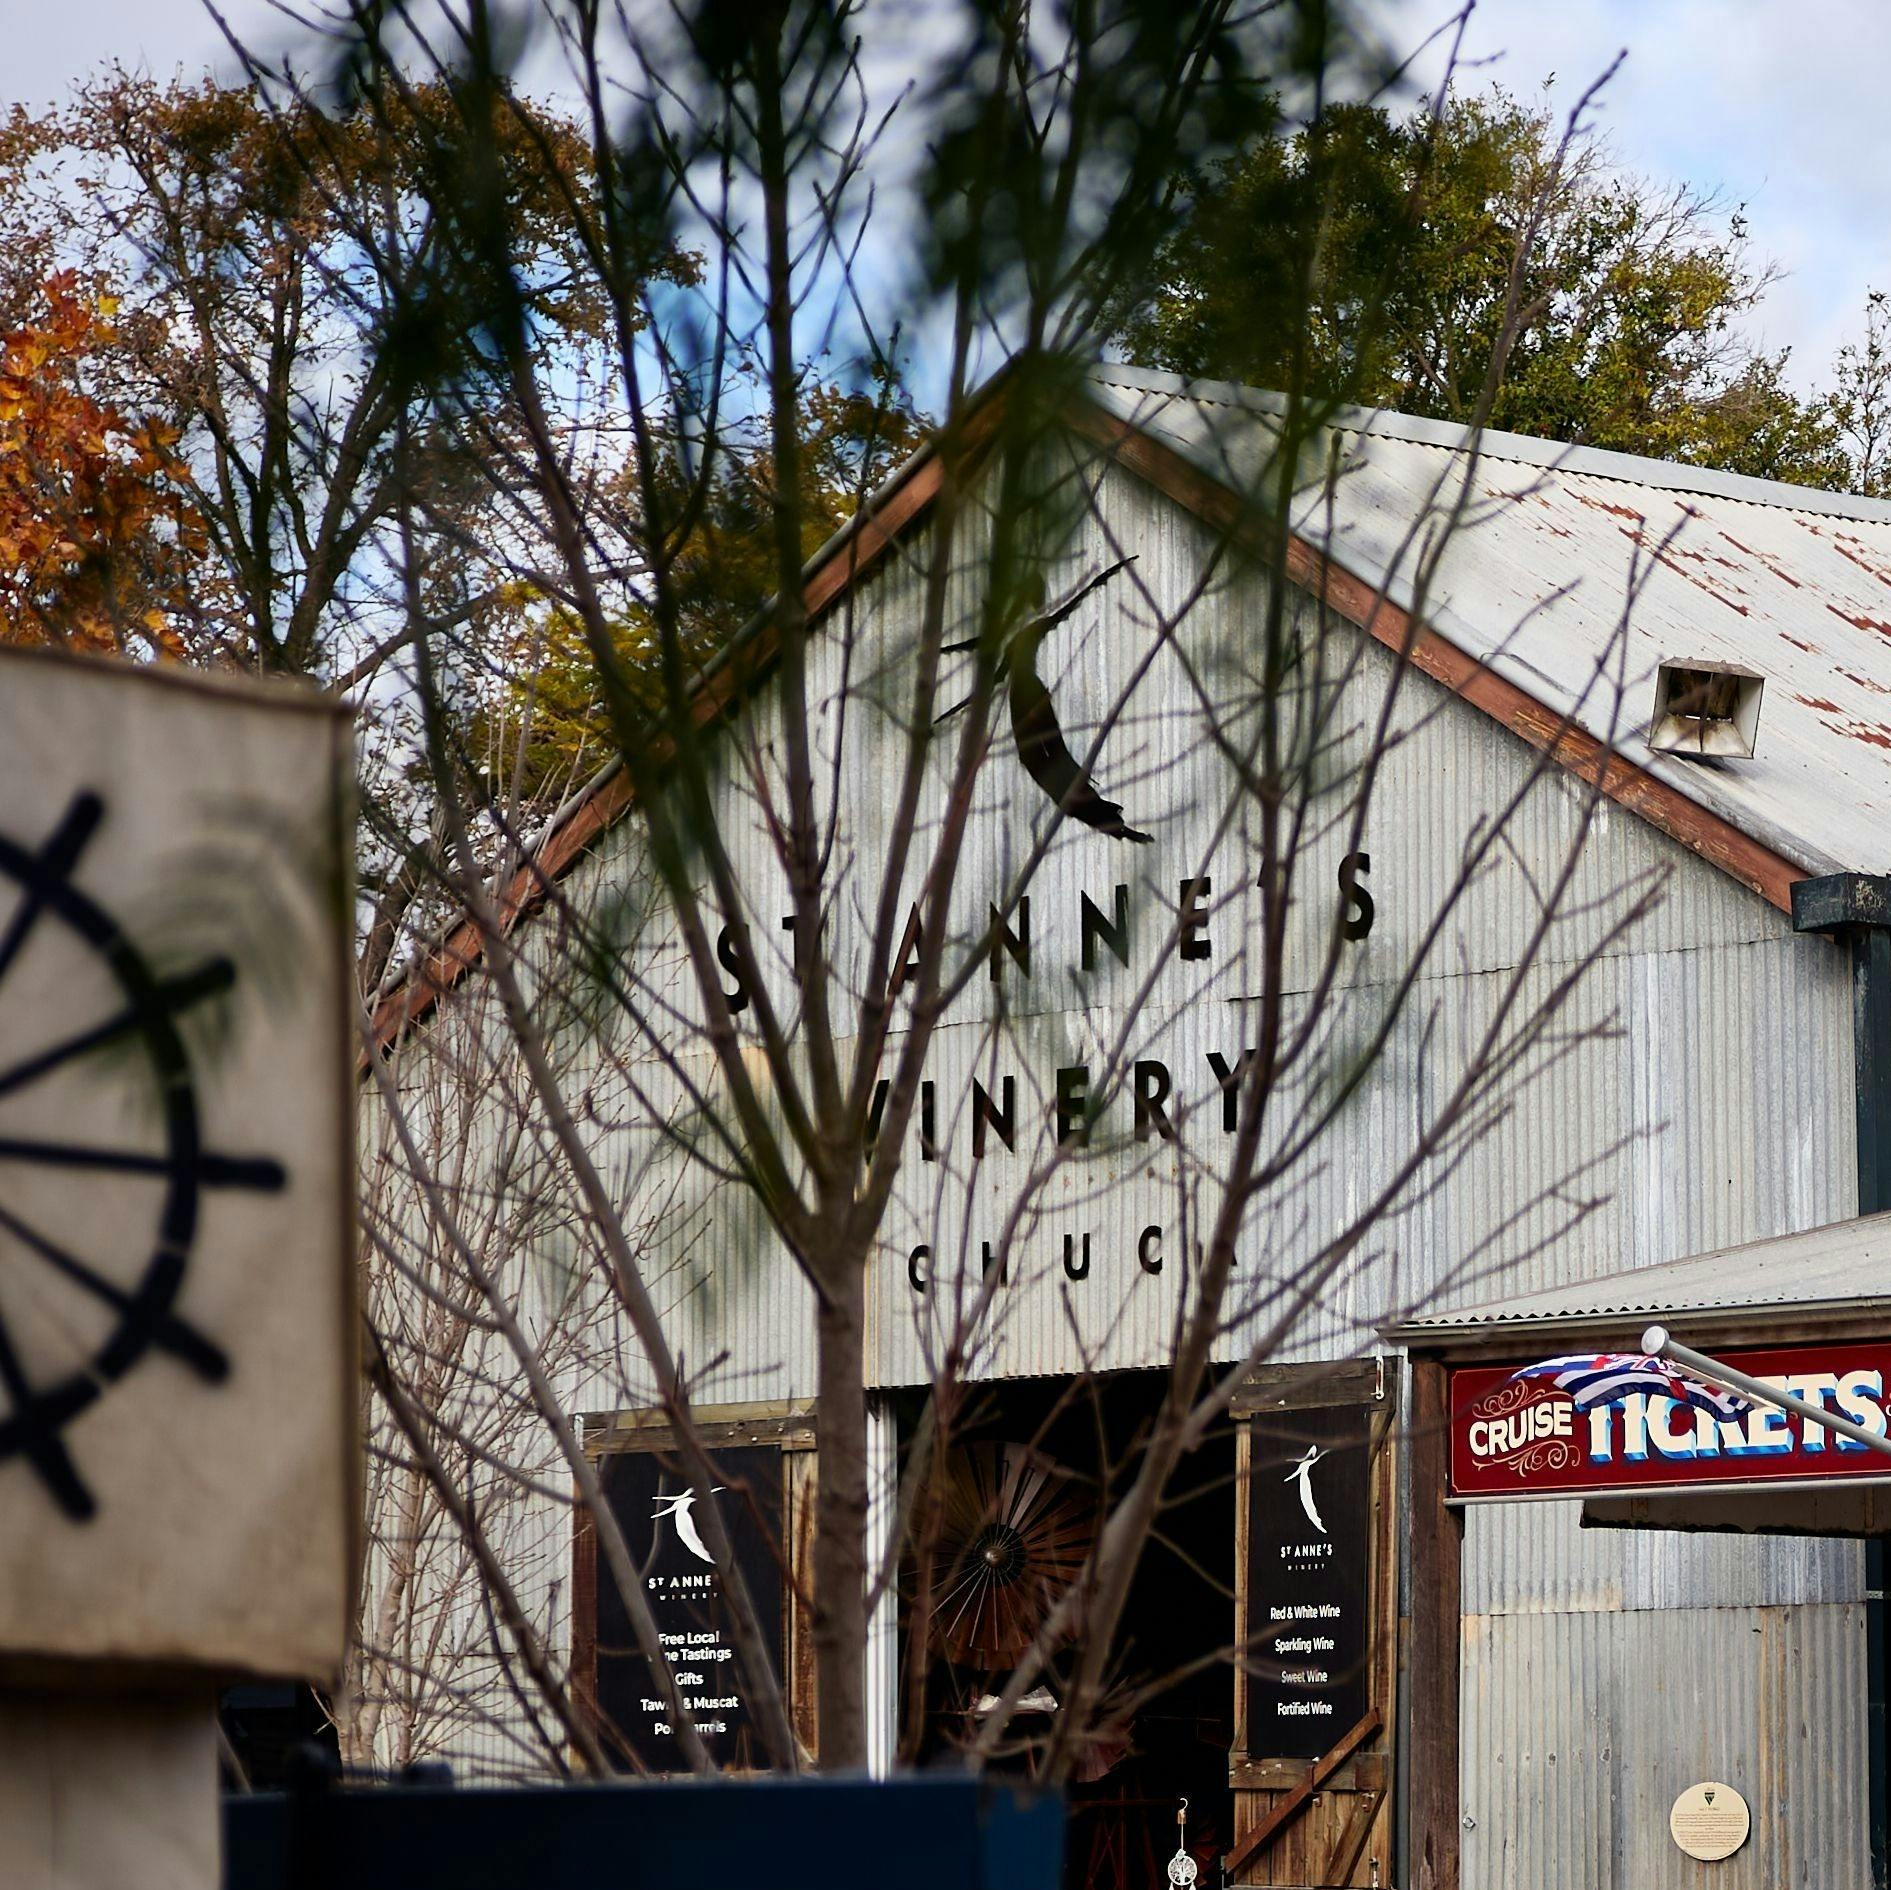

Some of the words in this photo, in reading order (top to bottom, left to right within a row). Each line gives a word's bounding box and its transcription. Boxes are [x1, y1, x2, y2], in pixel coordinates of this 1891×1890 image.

[1469, 1401, 1575, 1457] CRUISE
[1294, 1543, 1333, 1557] ANNE'S
[1270, 1606, 1286, 1620] Red
[1287, 1606, 1294, 1620] &
[1294, 1605, 1318, 1619] White
[1318, 1604, 1341, 1618] Wine
[658, 1632, 685, 1646] Free
[686, 1630, 721, 1645] Local
[1274, 1638, 1312, 1655] Sparkling
[1313, 1637, 1335, 1650] Wine
[680, 1647, 733, 1663] Tastings
[674, 1671, 705, 1686] Gifts
[1281, 1670, 1306, 1684] Sweet
[1306, 1669, 1329, 1683] Wine
[693, 1695, 740, 1710] Muscat
[1277, 1702, 1310, 1715] Fortified
[1310, 1701, 1333, 1715] Wine
